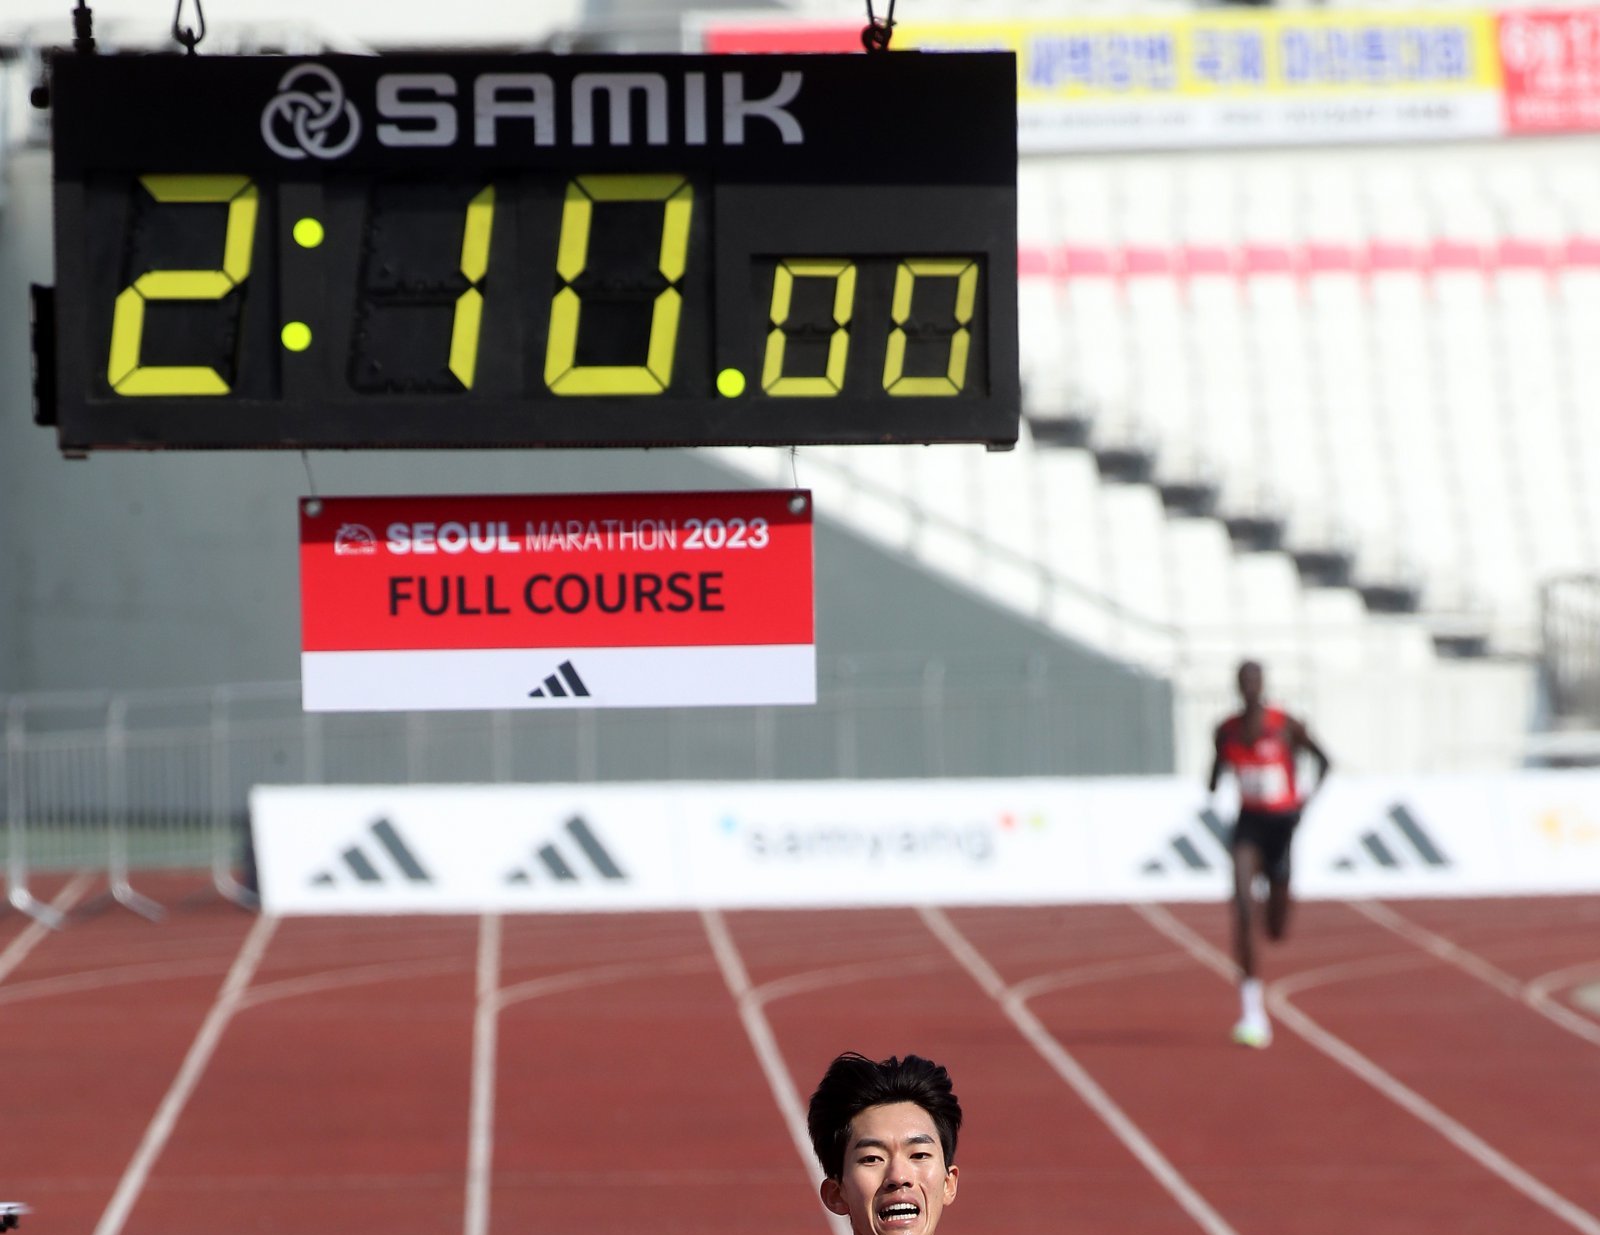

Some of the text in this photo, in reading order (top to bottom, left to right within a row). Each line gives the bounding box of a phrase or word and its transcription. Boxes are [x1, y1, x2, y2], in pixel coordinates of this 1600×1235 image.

[376, 72, 803, 146] SAMIK
[386, 516, 769, 554] SEOUL MARATHON 2023
[388, 571, 726, 616] FULL COURSE
